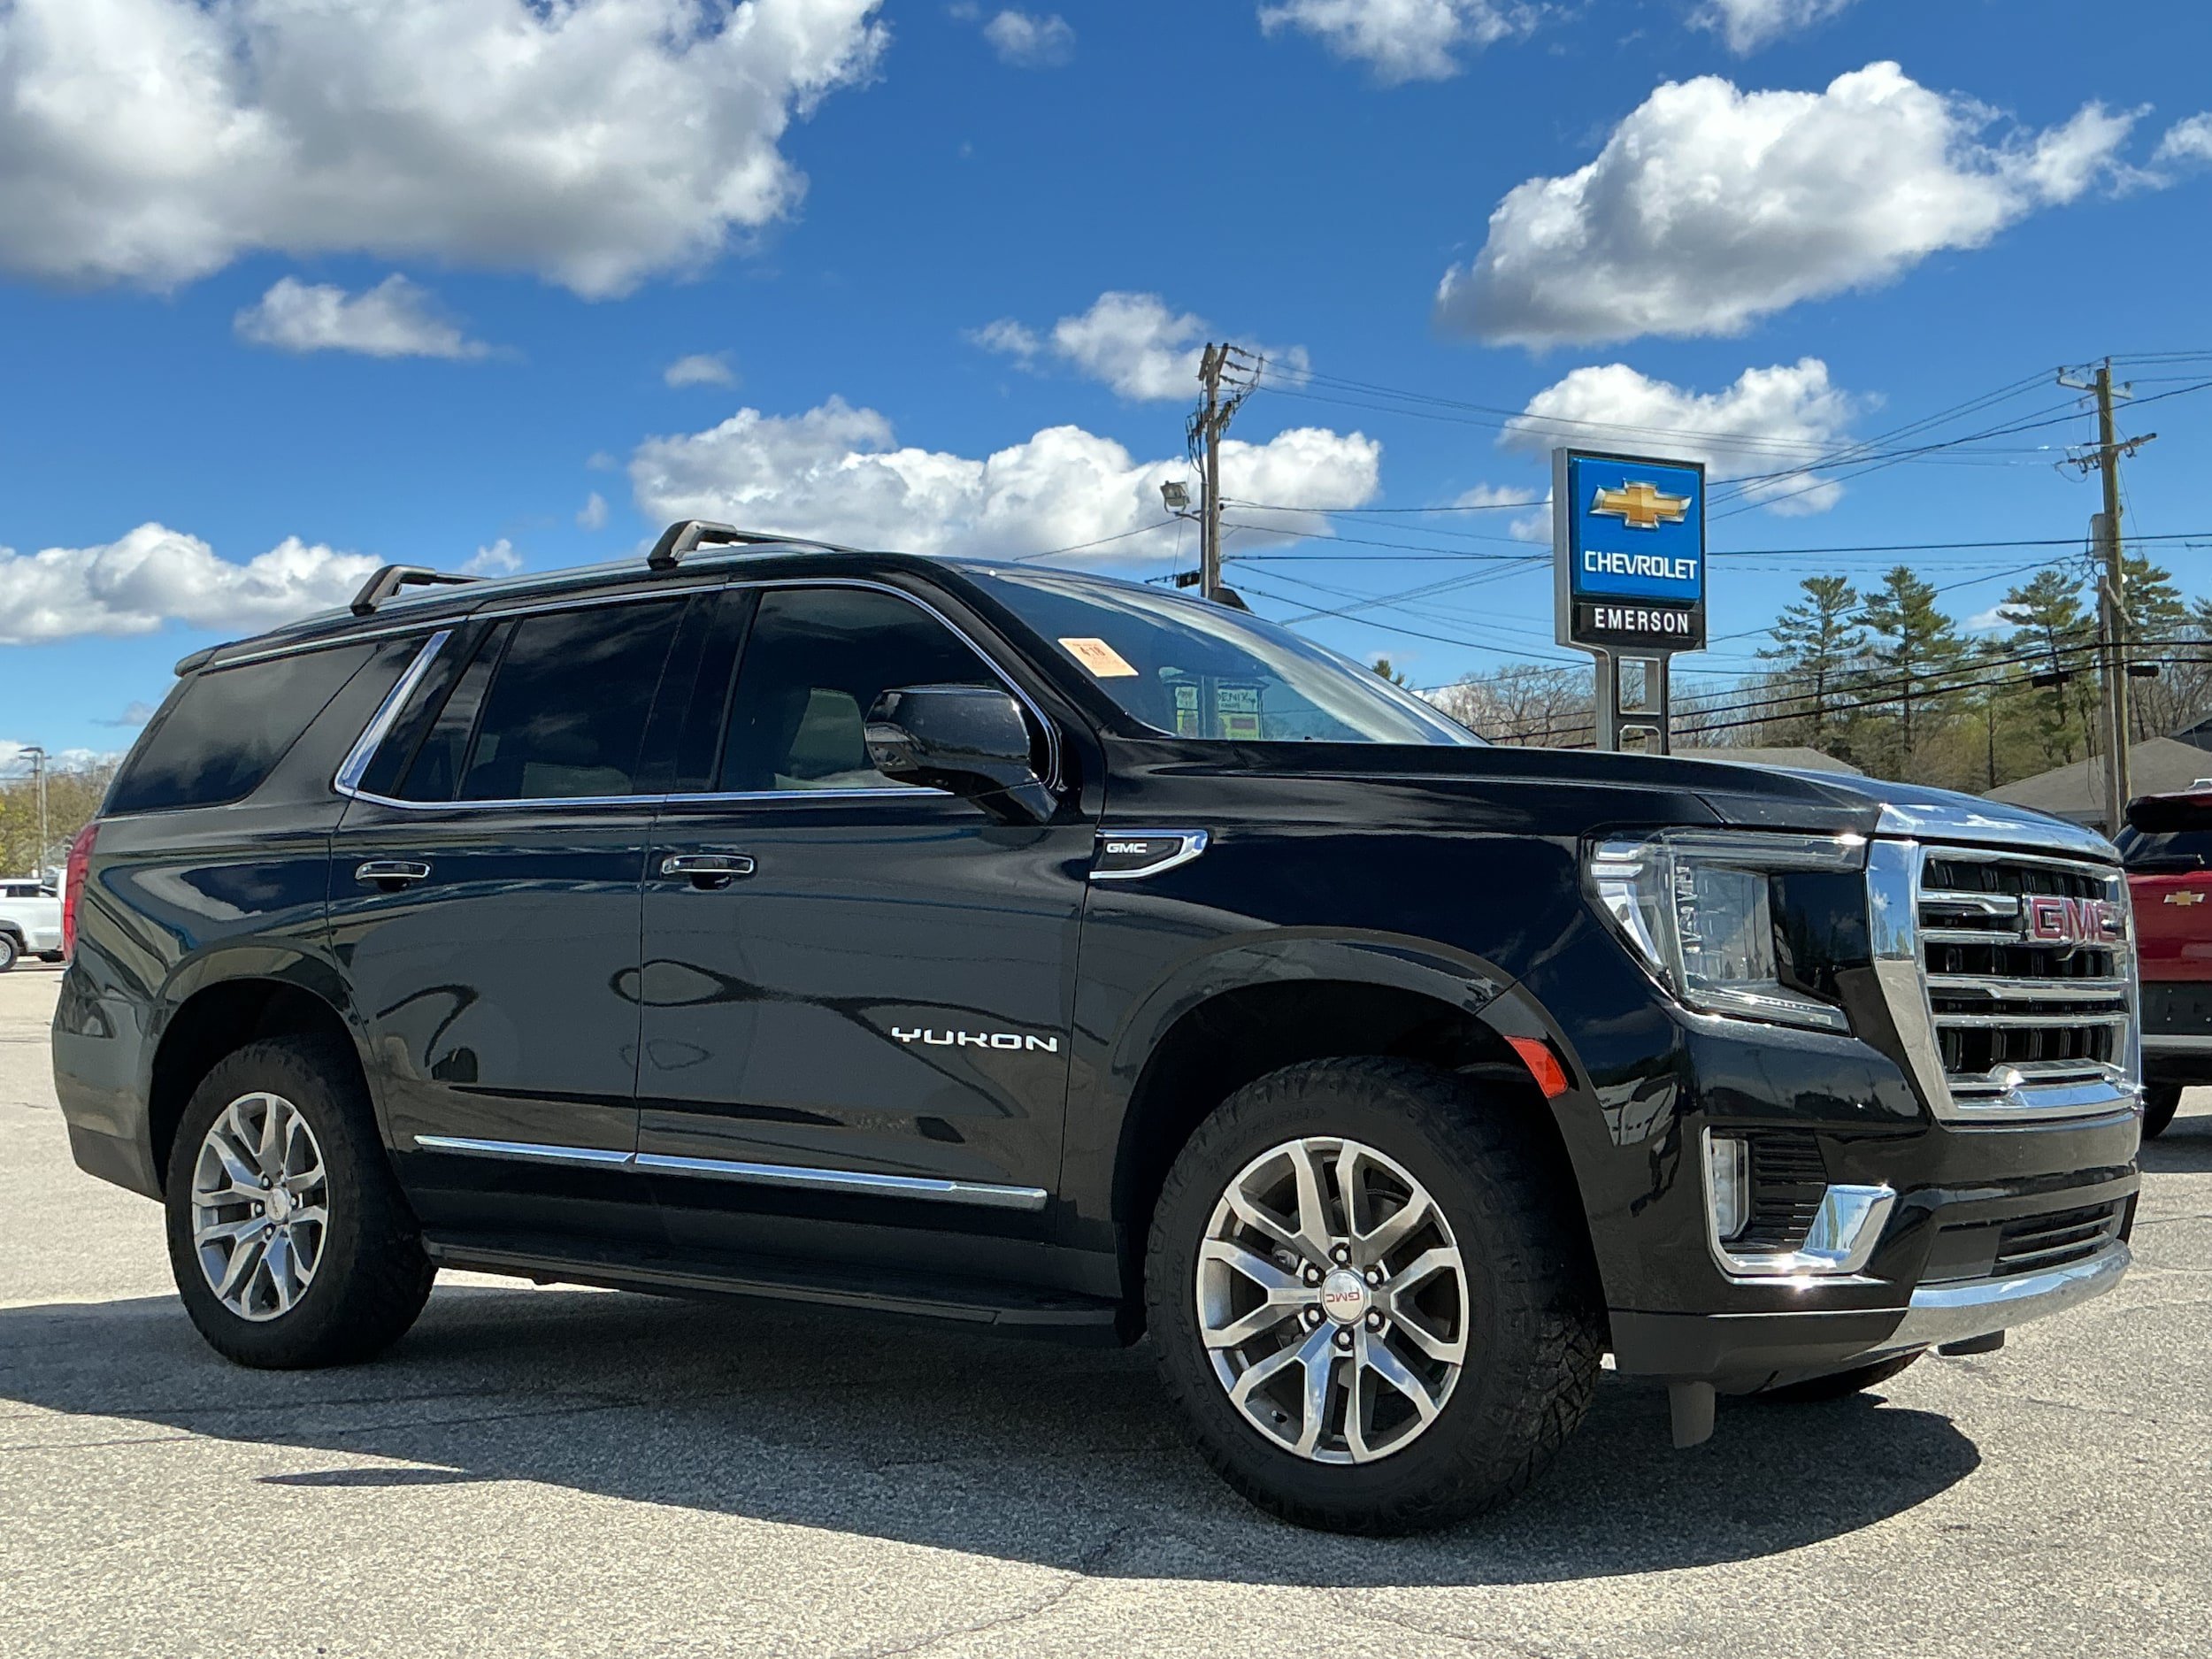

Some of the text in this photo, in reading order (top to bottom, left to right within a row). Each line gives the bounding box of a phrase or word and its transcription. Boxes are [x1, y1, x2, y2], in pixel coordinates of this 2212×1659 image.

[1584, 550, 1697, 580] CHEVROLET
[1594, 607, 1689, 634] EMERSON
[1107, 843, 1148, 854] GMC
[2032, 897, 2120, 943] GMC
[891, 1026, 1058, 1053] YUKON
[1325, 1292, 1360, 1302] GMC
